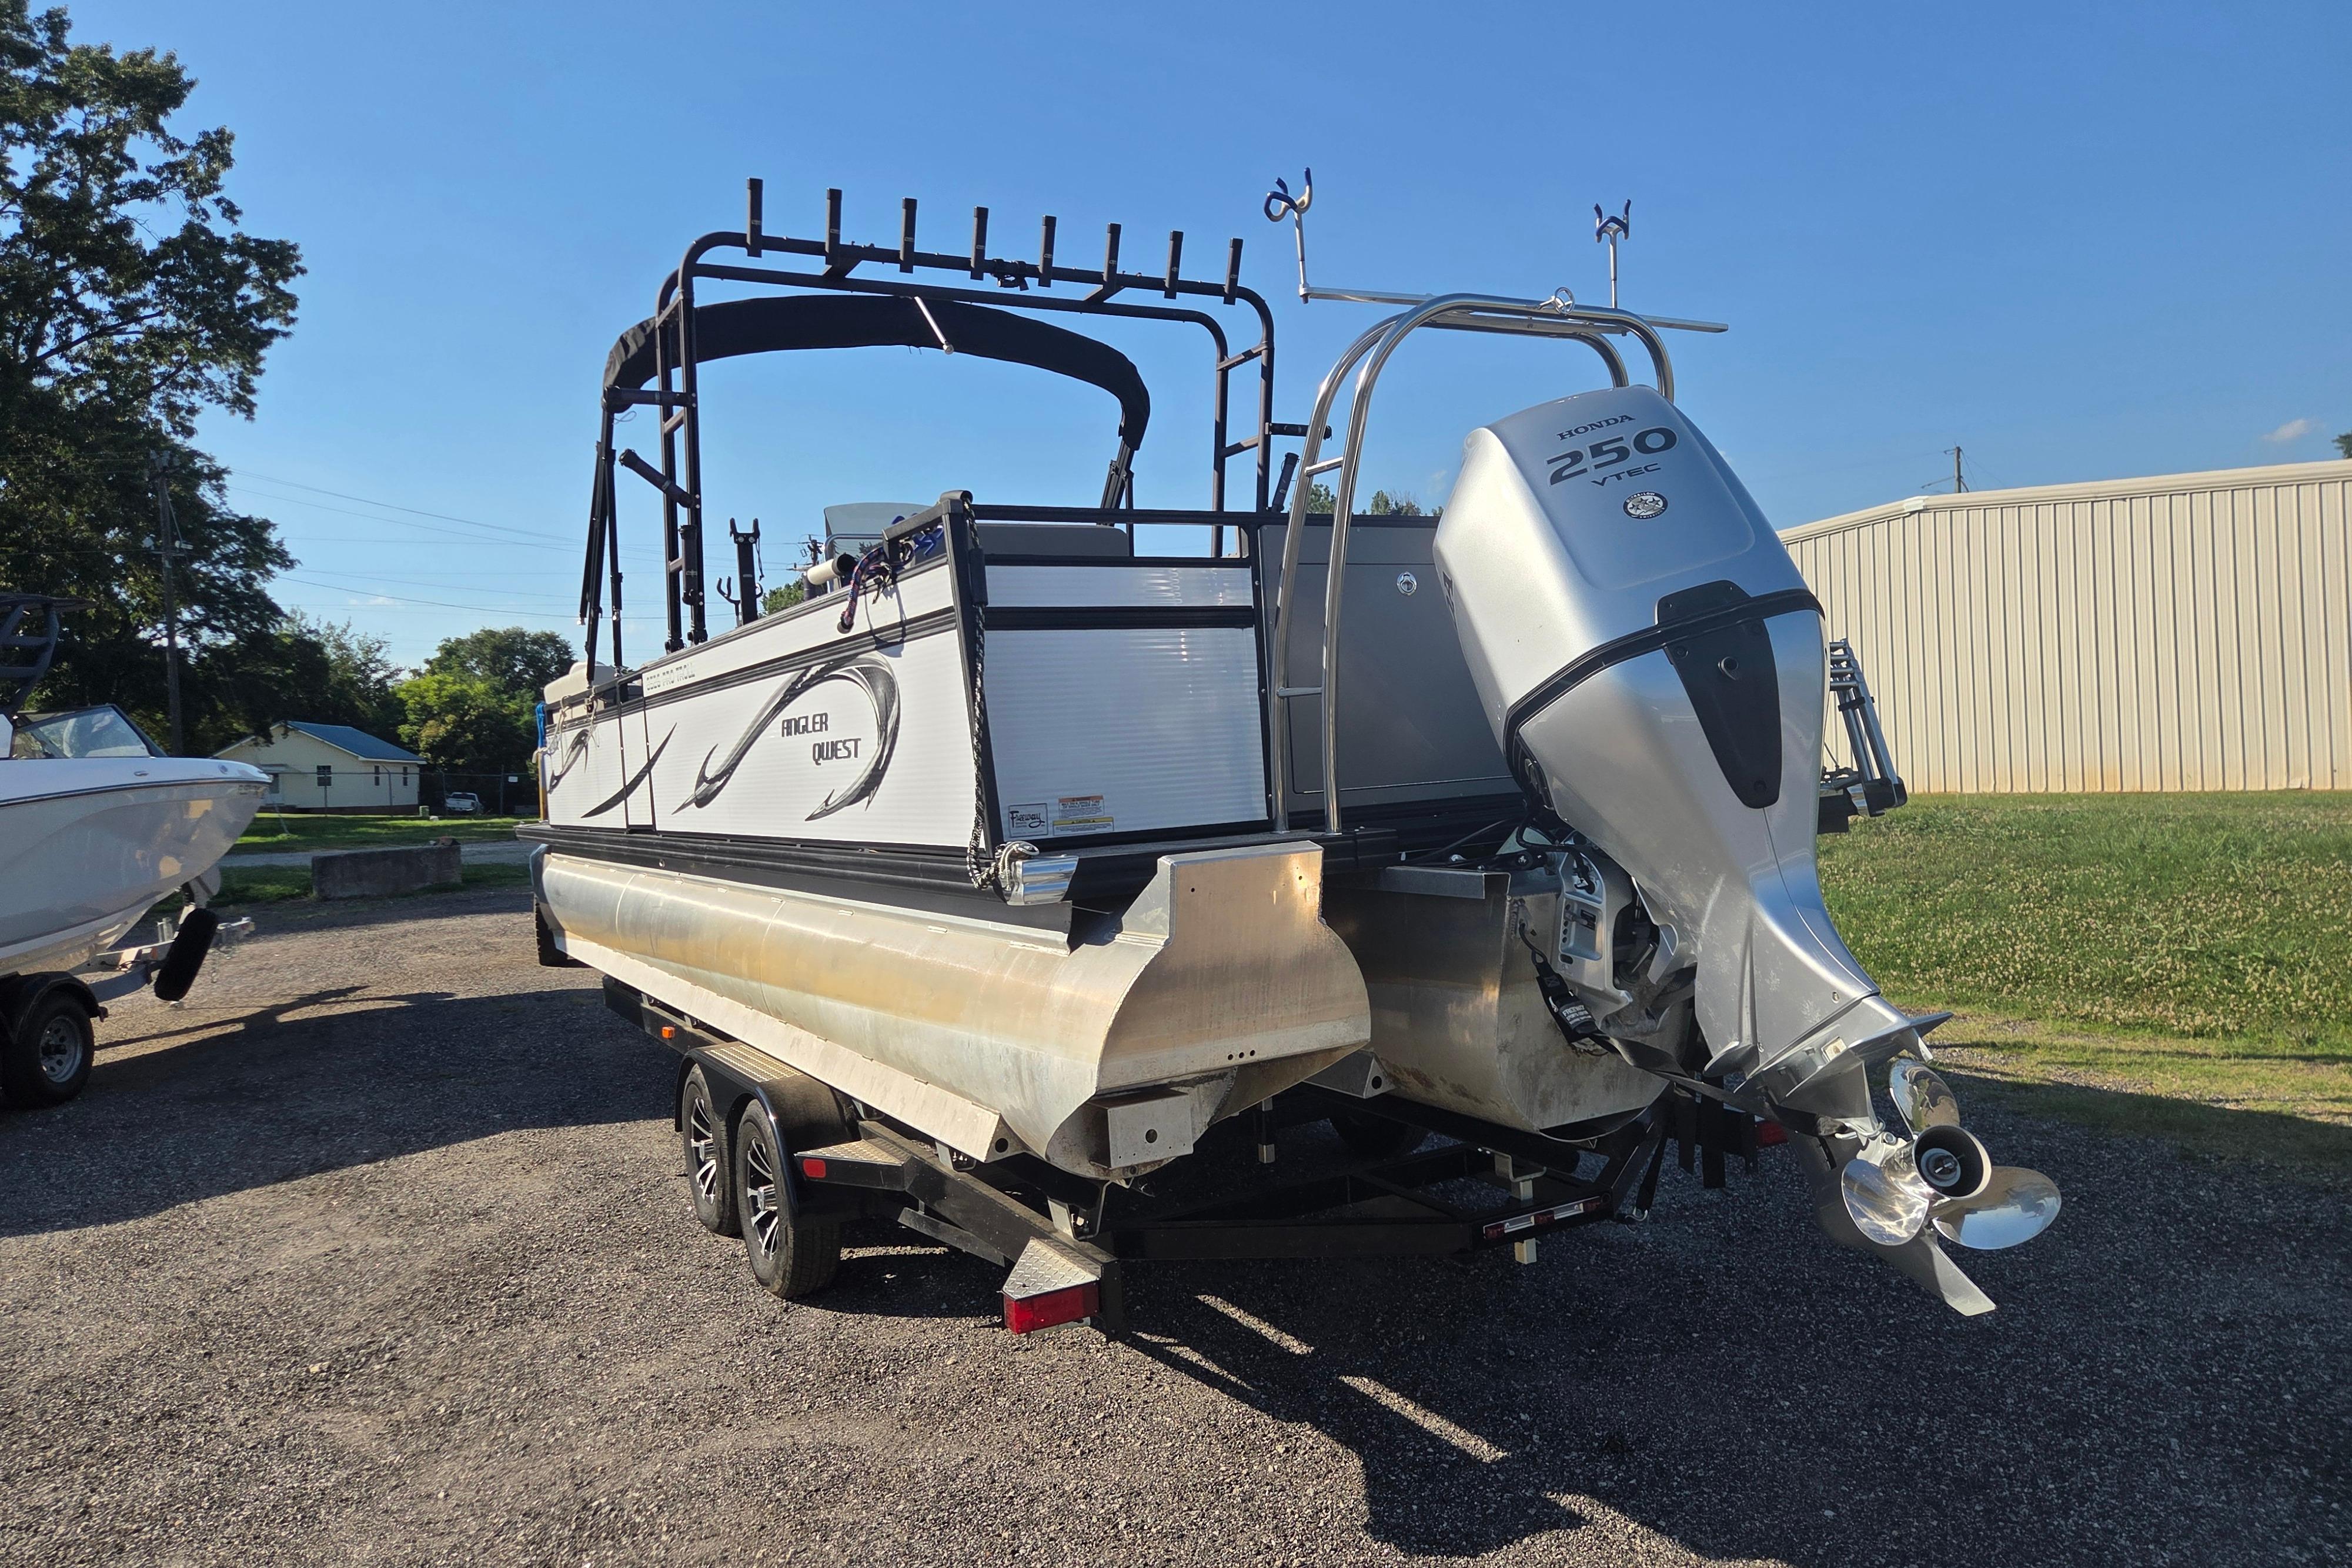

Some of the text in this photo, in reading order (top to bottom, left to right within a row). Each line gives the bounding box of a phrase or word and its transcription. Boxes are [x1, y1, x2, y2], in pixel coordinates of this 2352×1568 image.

[1556, 414, 1636, 441] HONDA
[1546, 427, 1678, 487] 250
[1591, 463, 1662, 487] VTEC
[781, 712, 828, 737] ANGLER
[812, 738, 861, 766] QWEST
[1008, 810, 1045, 828] Freeway
